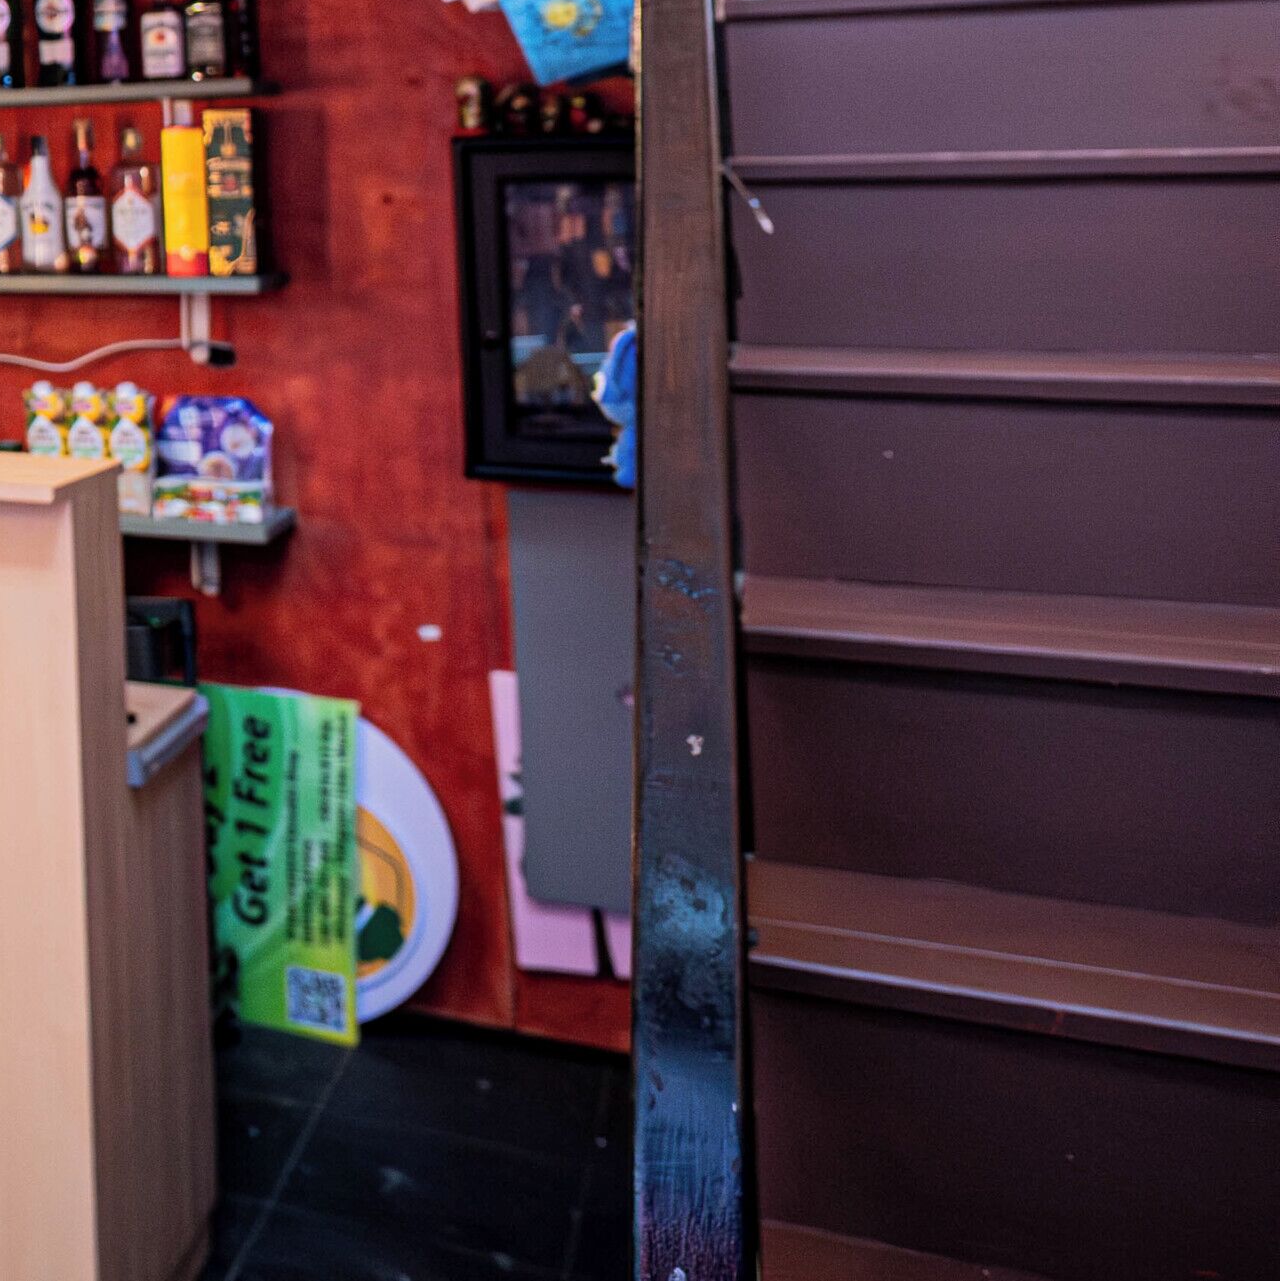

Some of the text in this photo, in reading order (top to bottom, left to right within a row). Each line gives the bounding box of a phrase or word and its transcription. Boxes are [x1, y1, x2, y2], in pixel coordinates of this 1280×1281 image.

[232, 715, 272, 926] Get 1 Free
